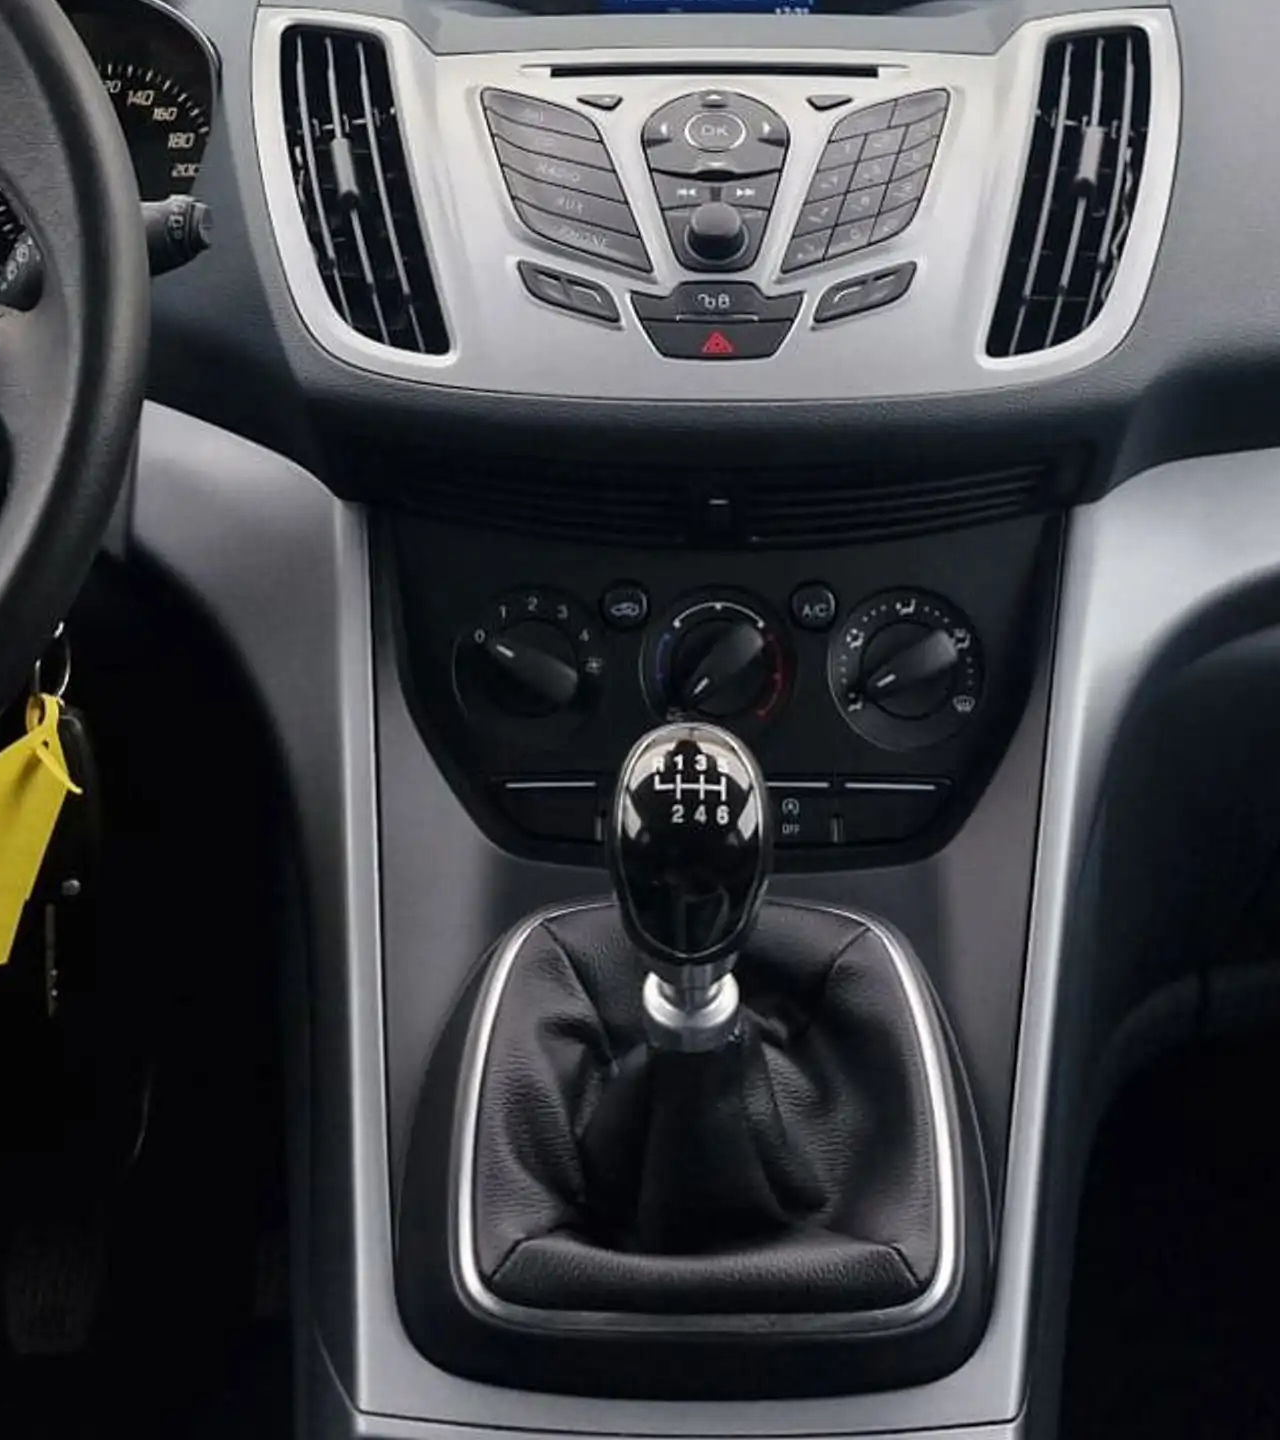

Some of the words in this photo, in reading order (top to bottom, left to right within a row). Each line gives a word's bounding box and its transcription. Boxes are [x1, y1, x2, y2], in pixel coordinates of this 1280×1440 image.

[126, 90, 154, 106] 140
[153, 107, 177, 121] 160
[701, 124, 729, 137] OK
[168, 132, 196, 148] 180
[528, 596, 538, 611] 2
[499, 605, 506, 619] 1
[557, 604, 568, 619] 3
[474, 629, 486, 644] 0
[579, 628, 590, 642] 4
[673, 754, 685, 772] 1
[694, 753, 708, 772] 3
[671, 804, 685, 824] 2
[694, 804, 708, 824] 4
[716, 804, 730, 826] 6
[782, 824, 801, 835] OFF
